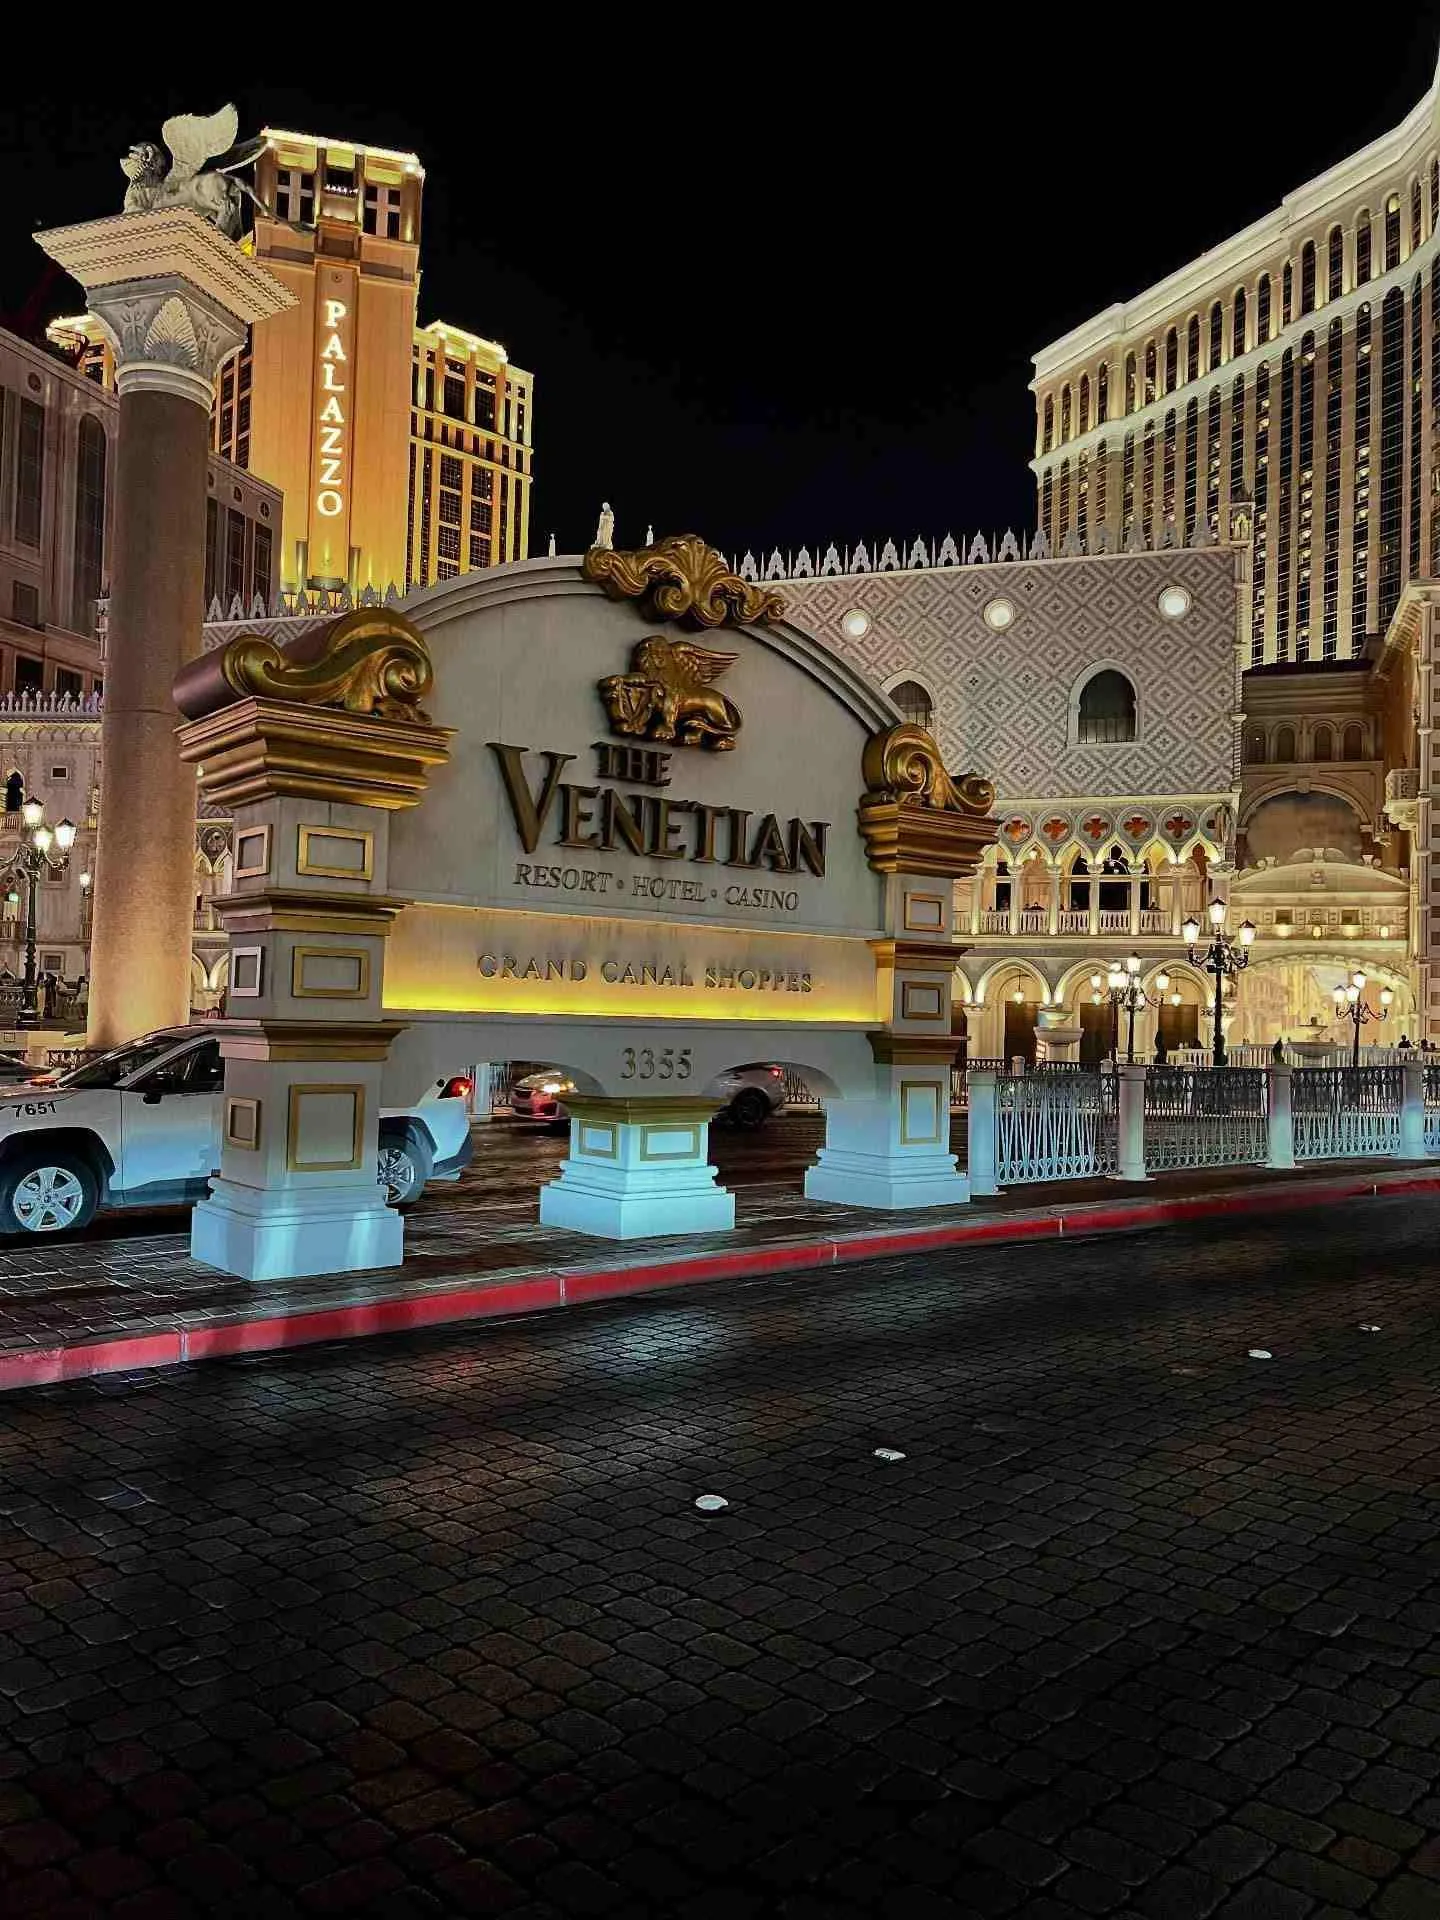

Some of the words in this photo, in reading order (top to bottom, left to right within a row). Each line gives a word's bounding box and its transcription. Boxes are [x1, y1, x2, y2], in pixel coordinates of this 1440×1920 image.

[317, 300, 347, 516] PALAZZO
[591, 741, 672, 787] THE
[486, 742, 831, 877] VENETIAN
[513, 863, 613, 893] RESORT
[631, 876, 706, 903] HOTEL
[724, 886, 799, 911] CASINO
[477, 953, 588, 983] GRAND
[601, 961, 694, 987] CANAL
[704, 966, 812, 993] SHOPPES
[620, 1047, 693, 1080] 3355
[13, 1101, 57, 1119] 7651
